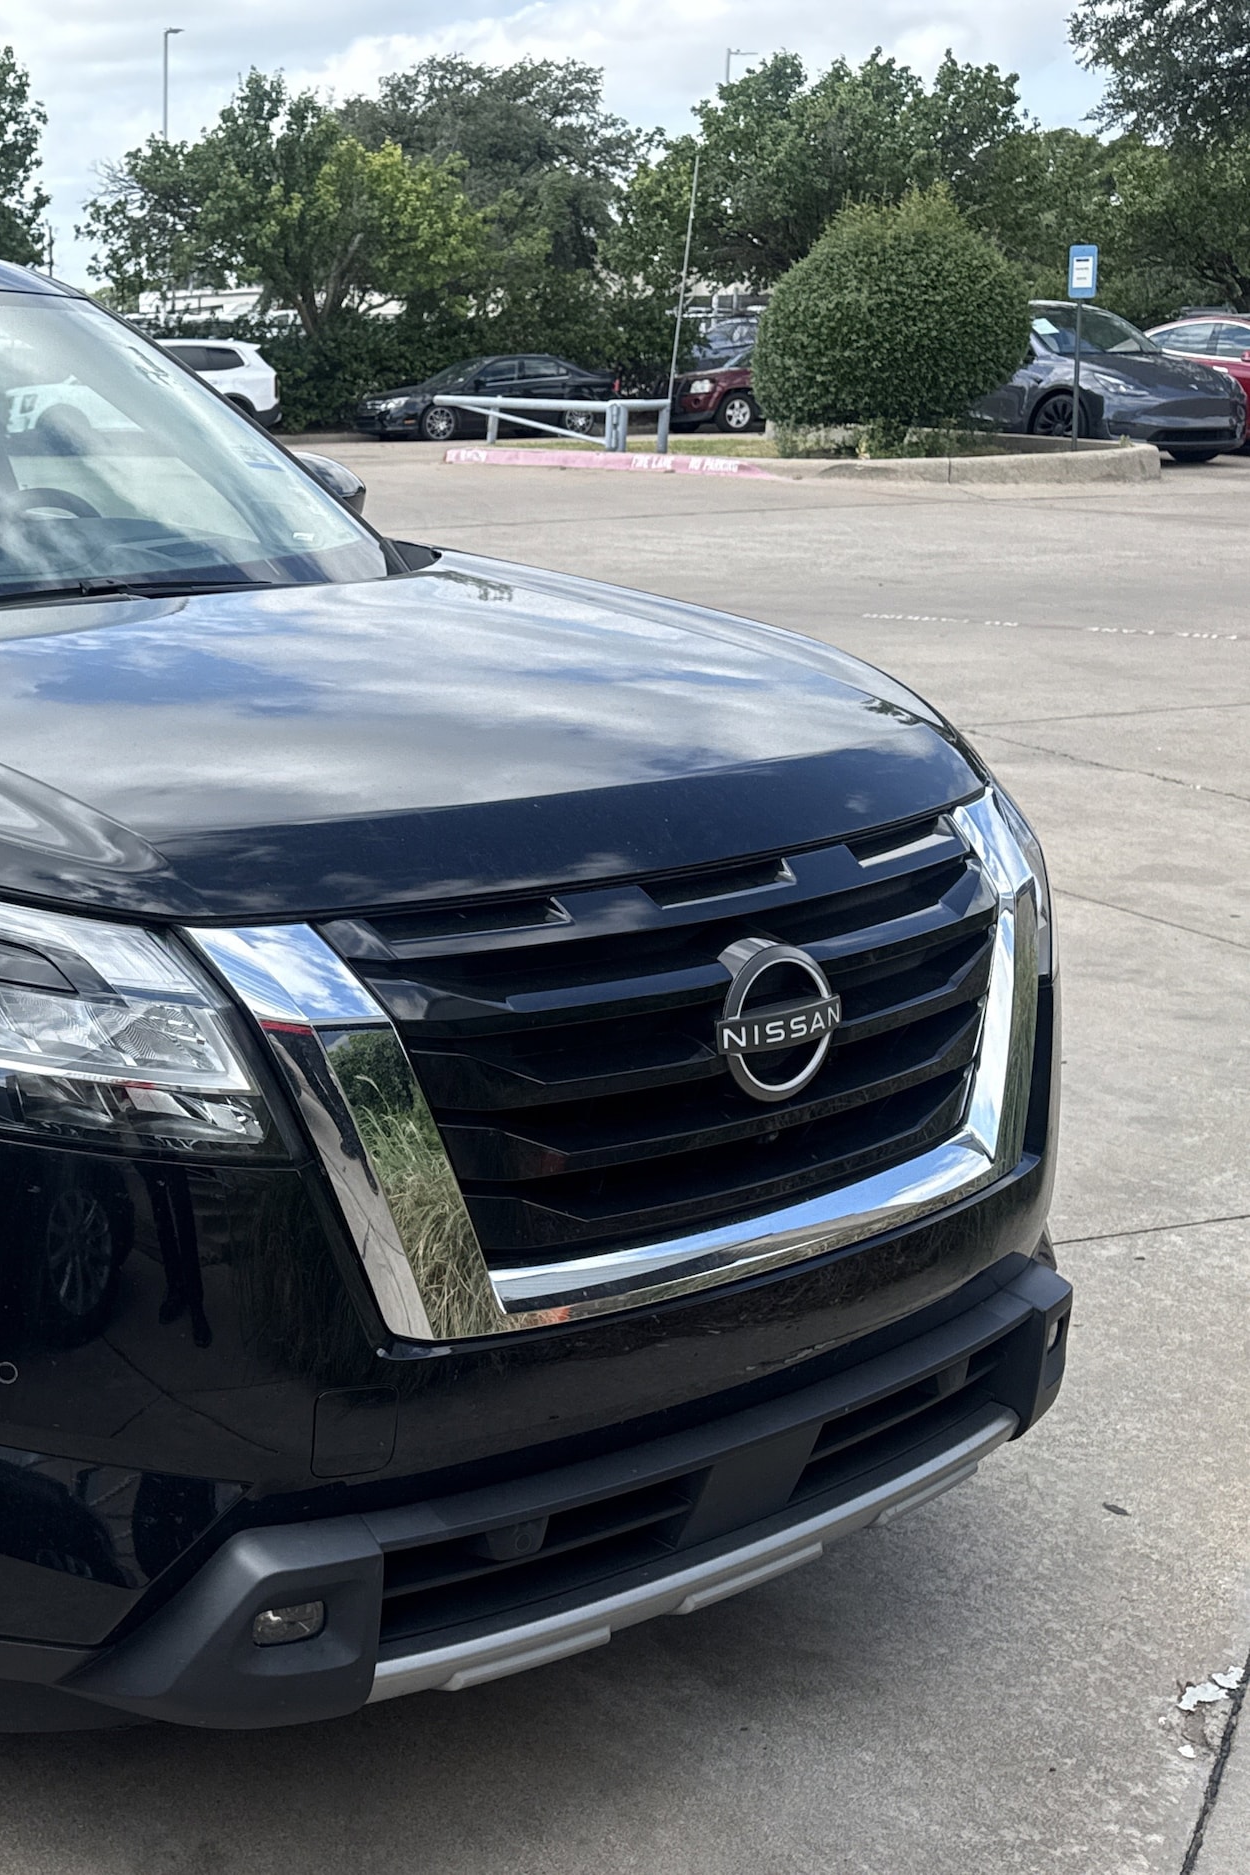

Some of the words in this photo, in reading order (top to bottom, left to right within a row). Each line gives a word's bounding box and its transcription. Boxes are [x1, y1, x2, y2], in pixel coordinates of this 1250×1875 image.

[651, 455, 674, 470] LANE
[702, 457, 739, 473] PARKING
[722, 1002, 840, 1049] NISSAN
